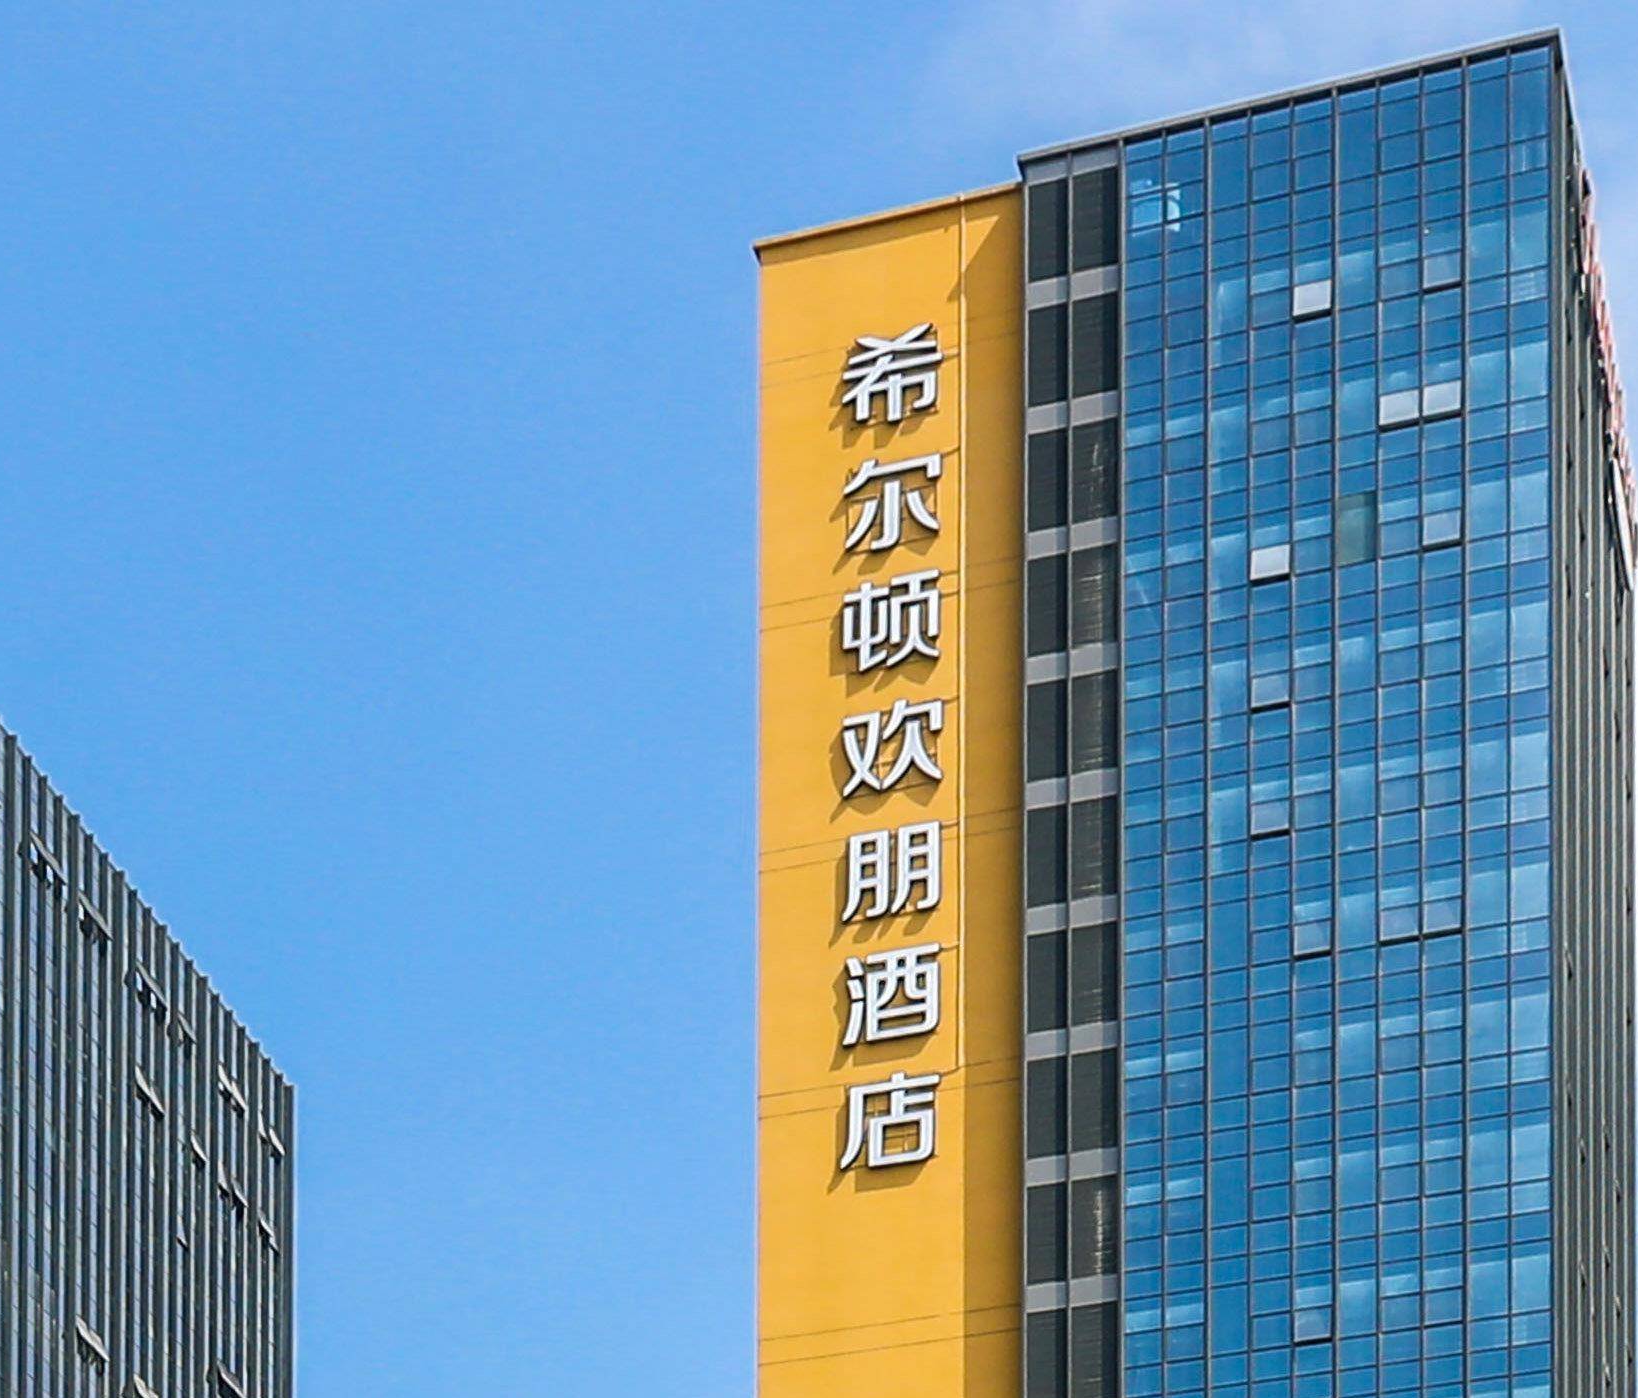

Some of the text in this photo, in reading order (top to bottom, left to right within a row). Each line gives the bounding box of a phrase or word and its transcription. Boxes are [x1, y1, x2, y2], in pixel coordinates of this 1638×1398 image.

[841, 322, 944, 1172] 希尔顿欢朋酒店
